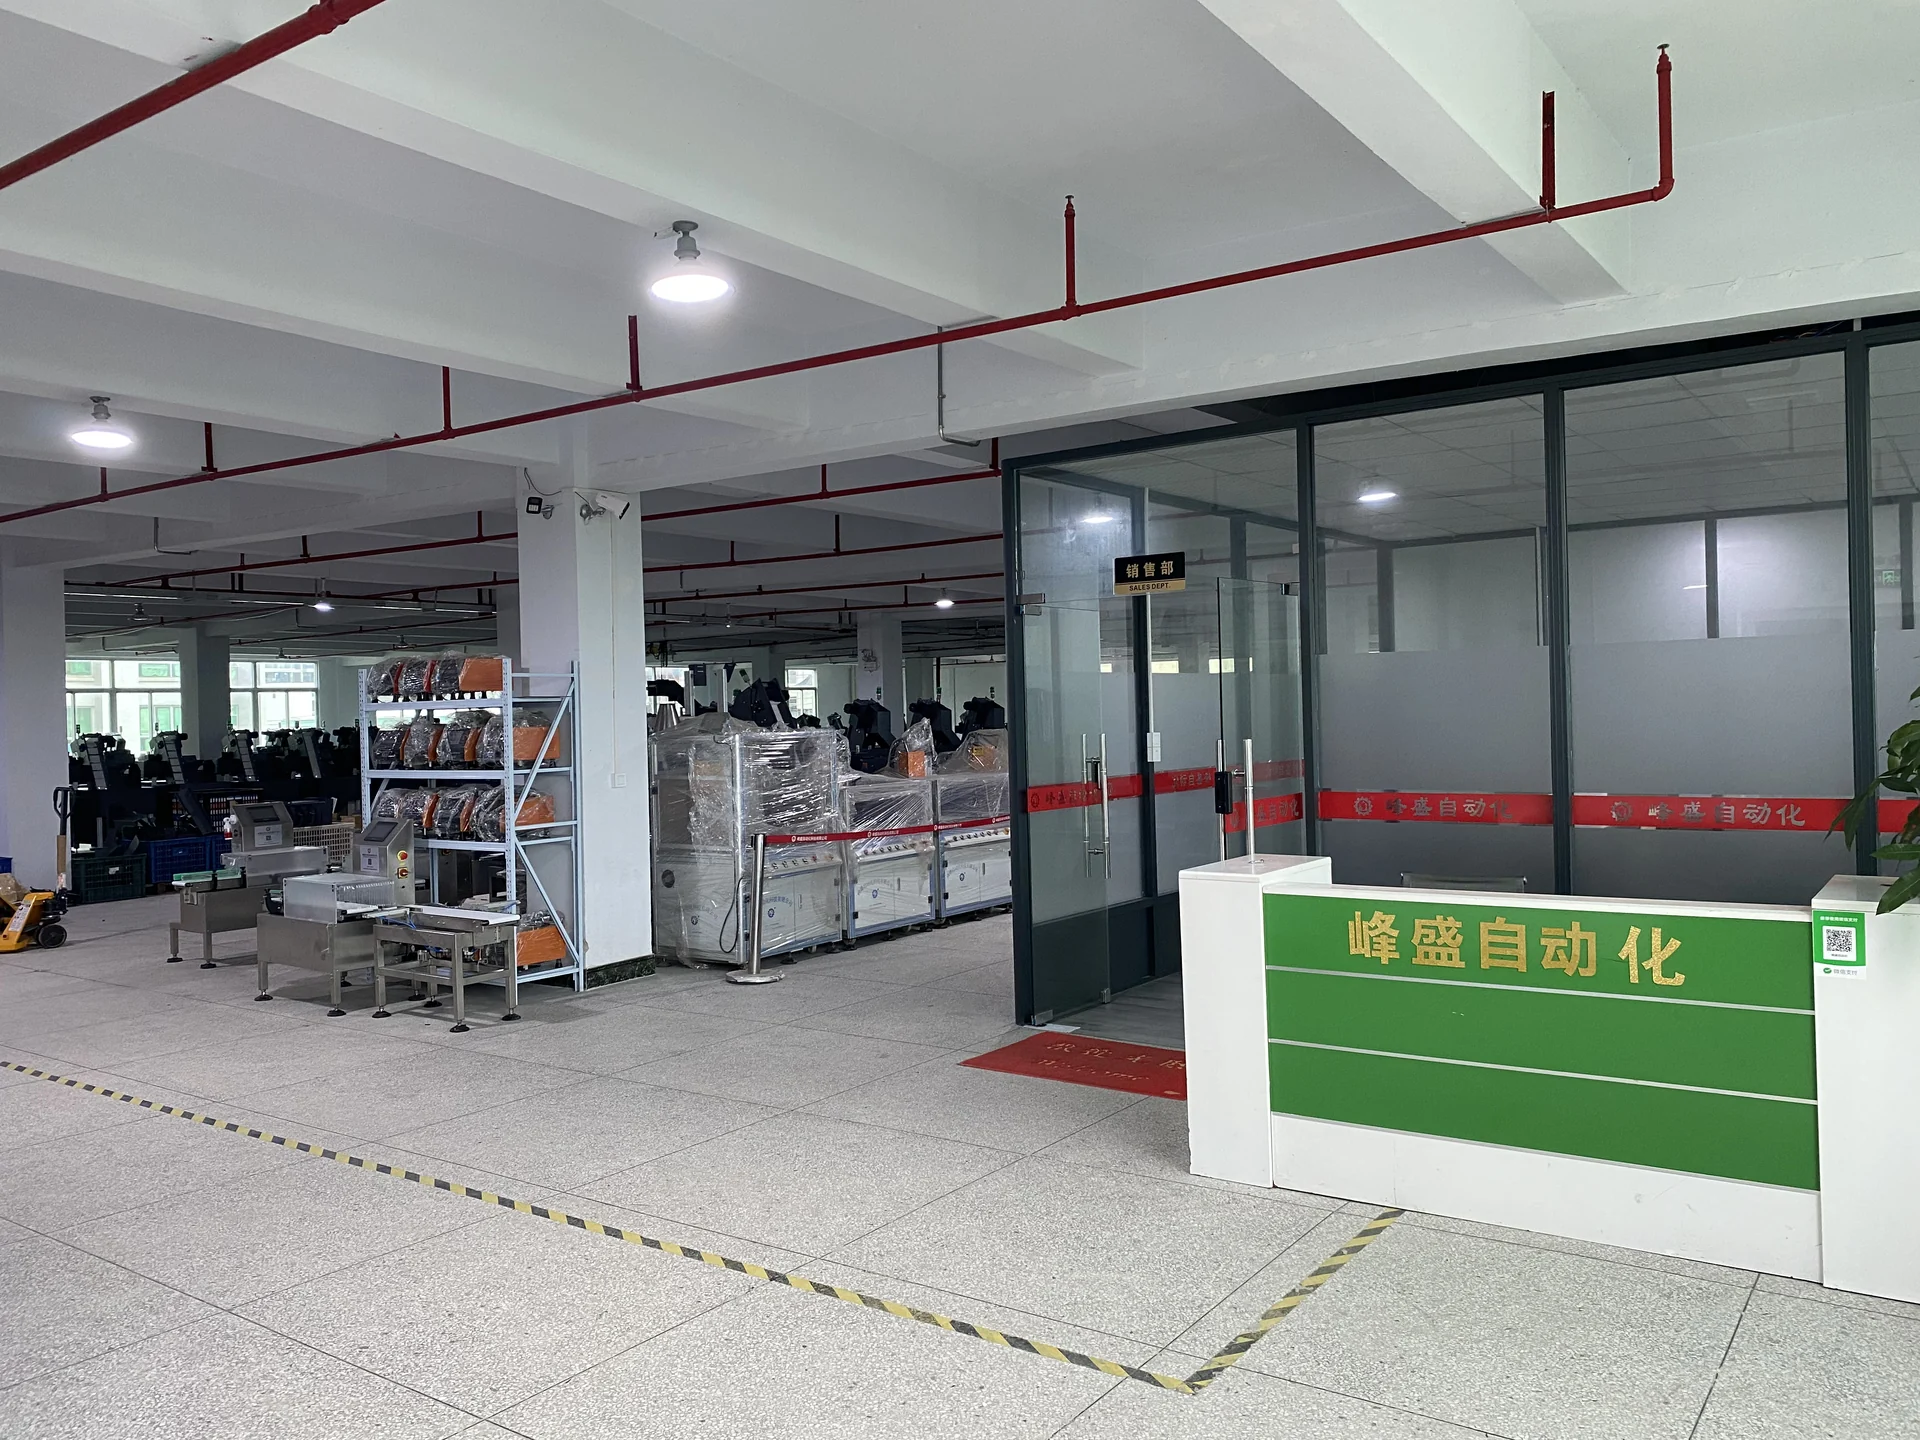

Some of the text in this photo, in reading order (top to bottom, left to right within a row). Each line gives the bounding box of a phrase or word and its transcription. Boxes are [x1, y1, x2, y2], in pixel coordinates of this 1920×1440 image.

[1126, 560, 1174, 578] 销售部
[1129, 582, 1171, 592] SALES DEPT.
[1386, 796, 1513, 819] 峰盛自动化
[1648, 801, 1806, 827] 峰盛自动化
[1348, 910, 1686, 987] 峰盛自动化
